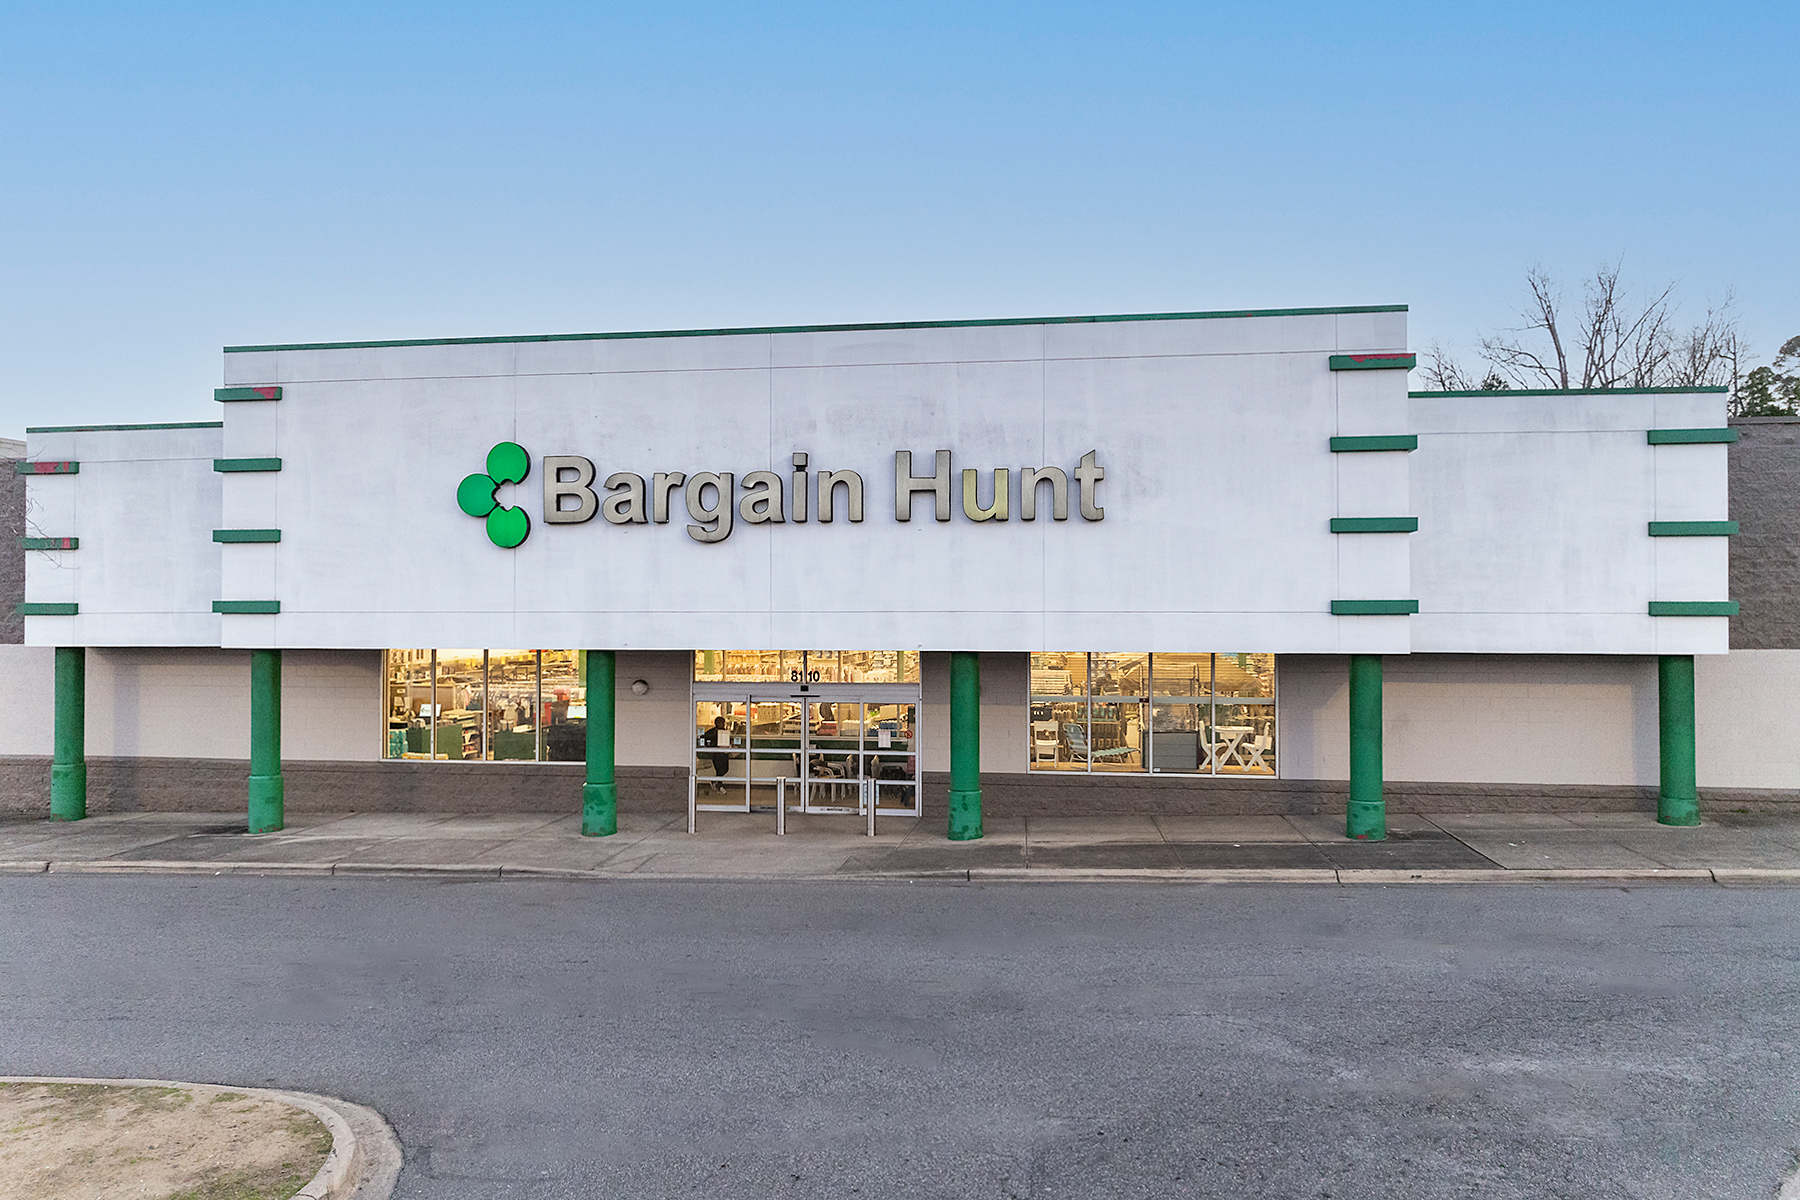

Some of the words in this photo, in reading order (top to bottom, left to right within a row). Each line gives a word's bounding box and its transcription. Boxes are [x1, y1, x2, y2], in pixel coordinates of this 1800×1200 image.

[543, 452, 864, 543] Bargain
[895, 449, 1104, 522] Hunt
[791, 670, 820, 682] 8110
